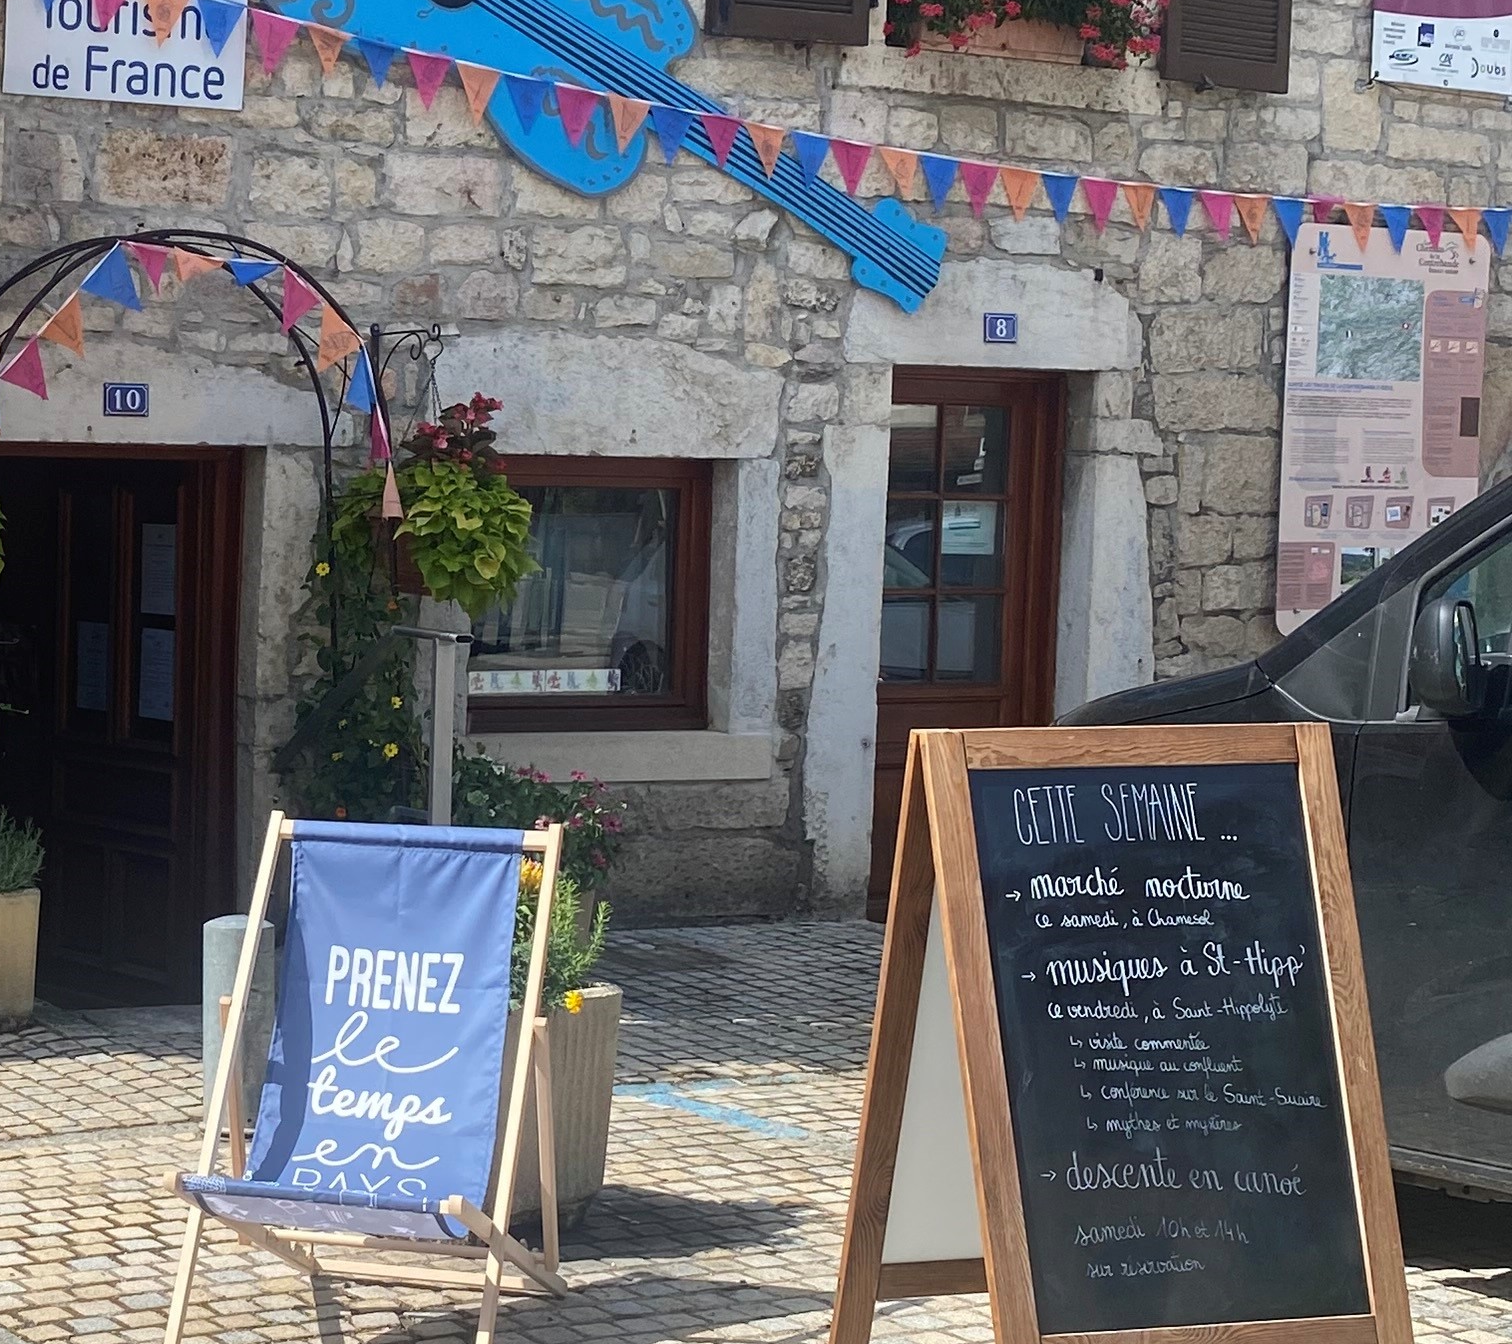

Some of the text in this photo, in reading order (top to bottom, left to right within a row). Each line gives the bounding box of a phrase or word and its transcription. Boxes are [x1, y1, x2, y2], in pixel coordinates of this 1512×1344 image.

[33, 45, 225, 101] de France
[996, 319, 1006, 337] 8
[114, 390, 141, 411] 10
[1013, 784, 1085, 845] CETTE
[1100, 782, 1206, 842] SEMAINE
[1030, 865, 1251, 901] marché nocturne
[1130, 908, 1144, 928] à
[324, 944, 466, 1015] PRENEZ
[1045, 950, 1169, 997] musiques
[1179, 945, 1199, 977] à
[1152, 1000, 1166, 1020] à
[311, 1010, 460, 1074] le
[1088, 1031, 1128, 1051] visite
[1092, 1053, 1244, 1080] musique au confluent
[306, 1064, 452, 1141] temps
[1100, 1081, 1171, 1107] conférence
[1176, 1088, 1199, 1101] sur
[1105, 1111, 1162, 1140] mythes
[1166, 1113, 1180, 1130] et
[291, 1138, 441, 1171] en
[1066, 1145, 1183, 1191] descente
[1188, 1166, 1224, 1192] en
[1072, 1215, 1250, 1247] samedi 10h et 14h
[1086, 1261, 1115, 1279] sur
